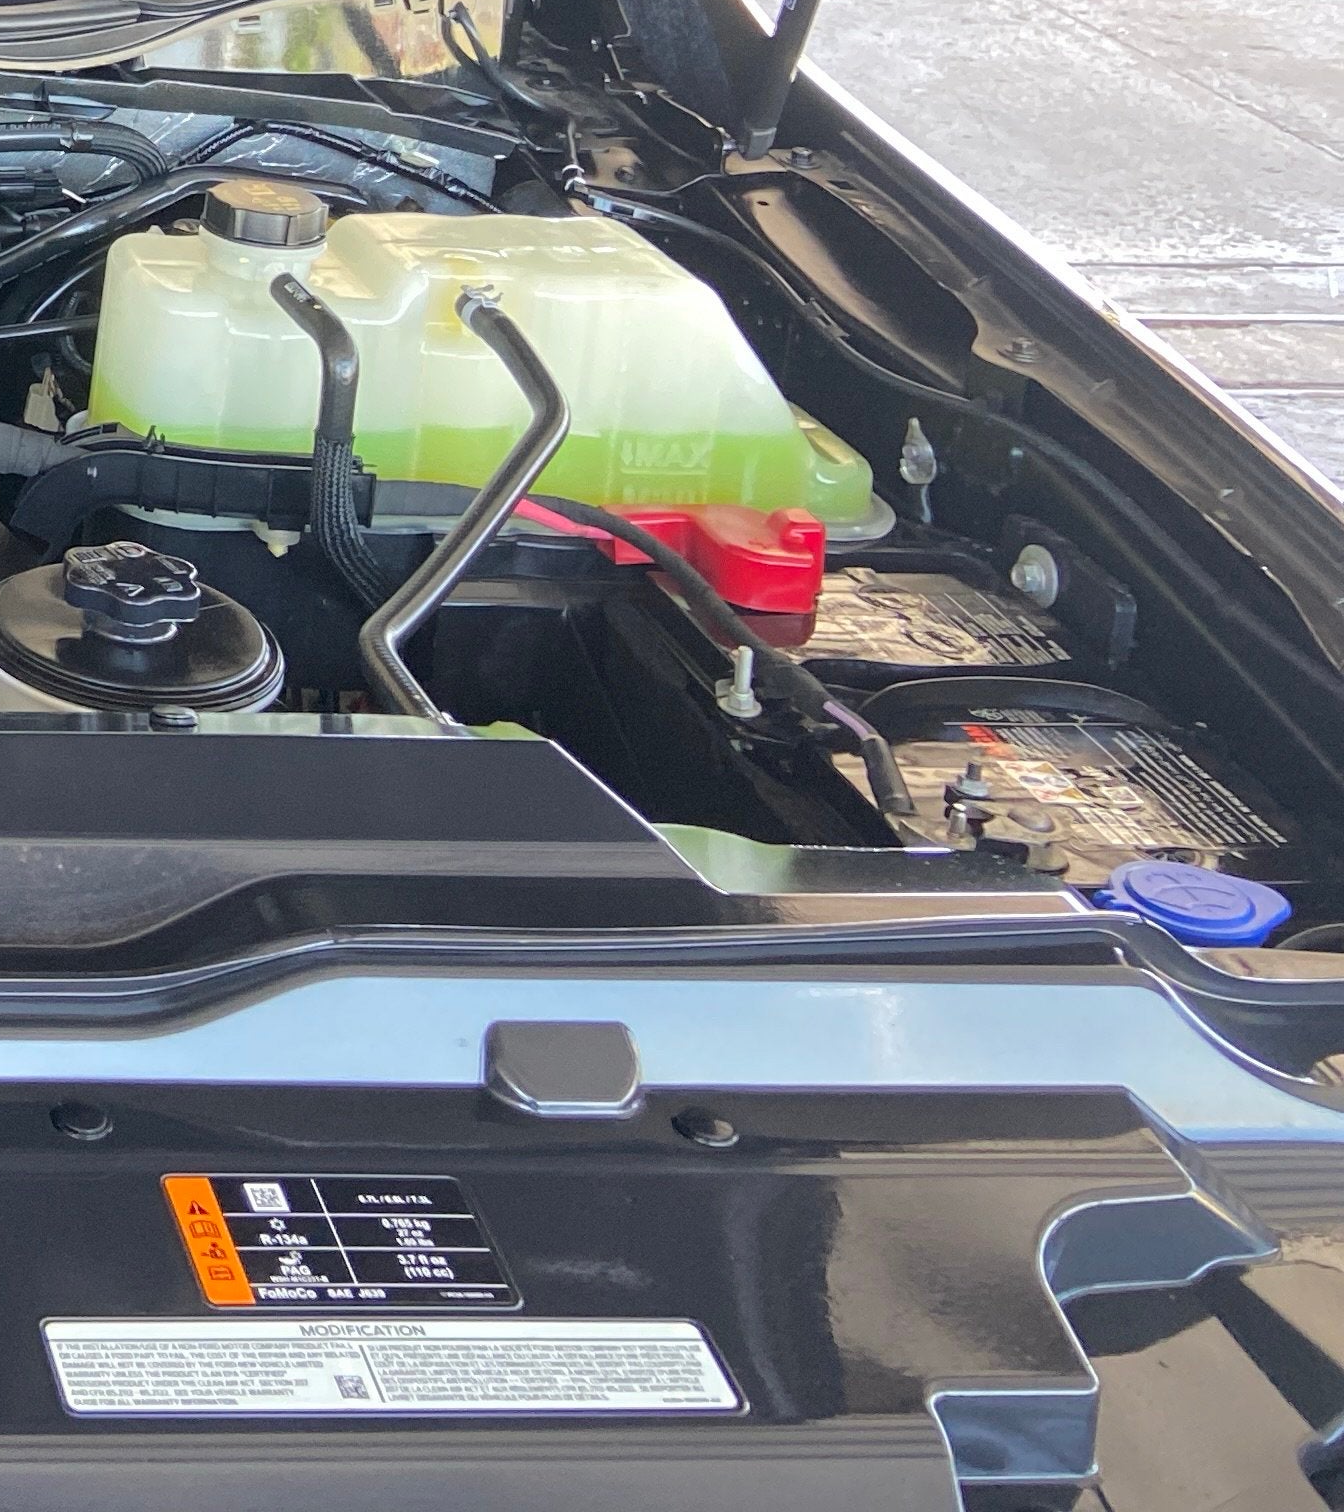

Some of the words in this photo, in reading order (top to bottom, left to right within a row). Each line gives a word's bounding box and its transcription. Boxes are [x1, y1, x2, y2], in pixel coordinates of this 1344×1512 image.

[636, 441, 709, 467] MAX
[413, 1218, 431, 1232] kg
[258, 1233, 309, 1246] R-134a
[397, 1254, 416, 1266] 3.7
[430, 1255, 447, 1266] oz
[280, 1265, 312, 1276] PAG
[404, 1266, 432, 1280] (110
[432, 1266, 455, 1280] cc)
[257, 1287, 318, 1300] FoMoCo
[327, 1288, 354, 1299] SAE
[299, 1324, 426, 1337] MODIFICATION
